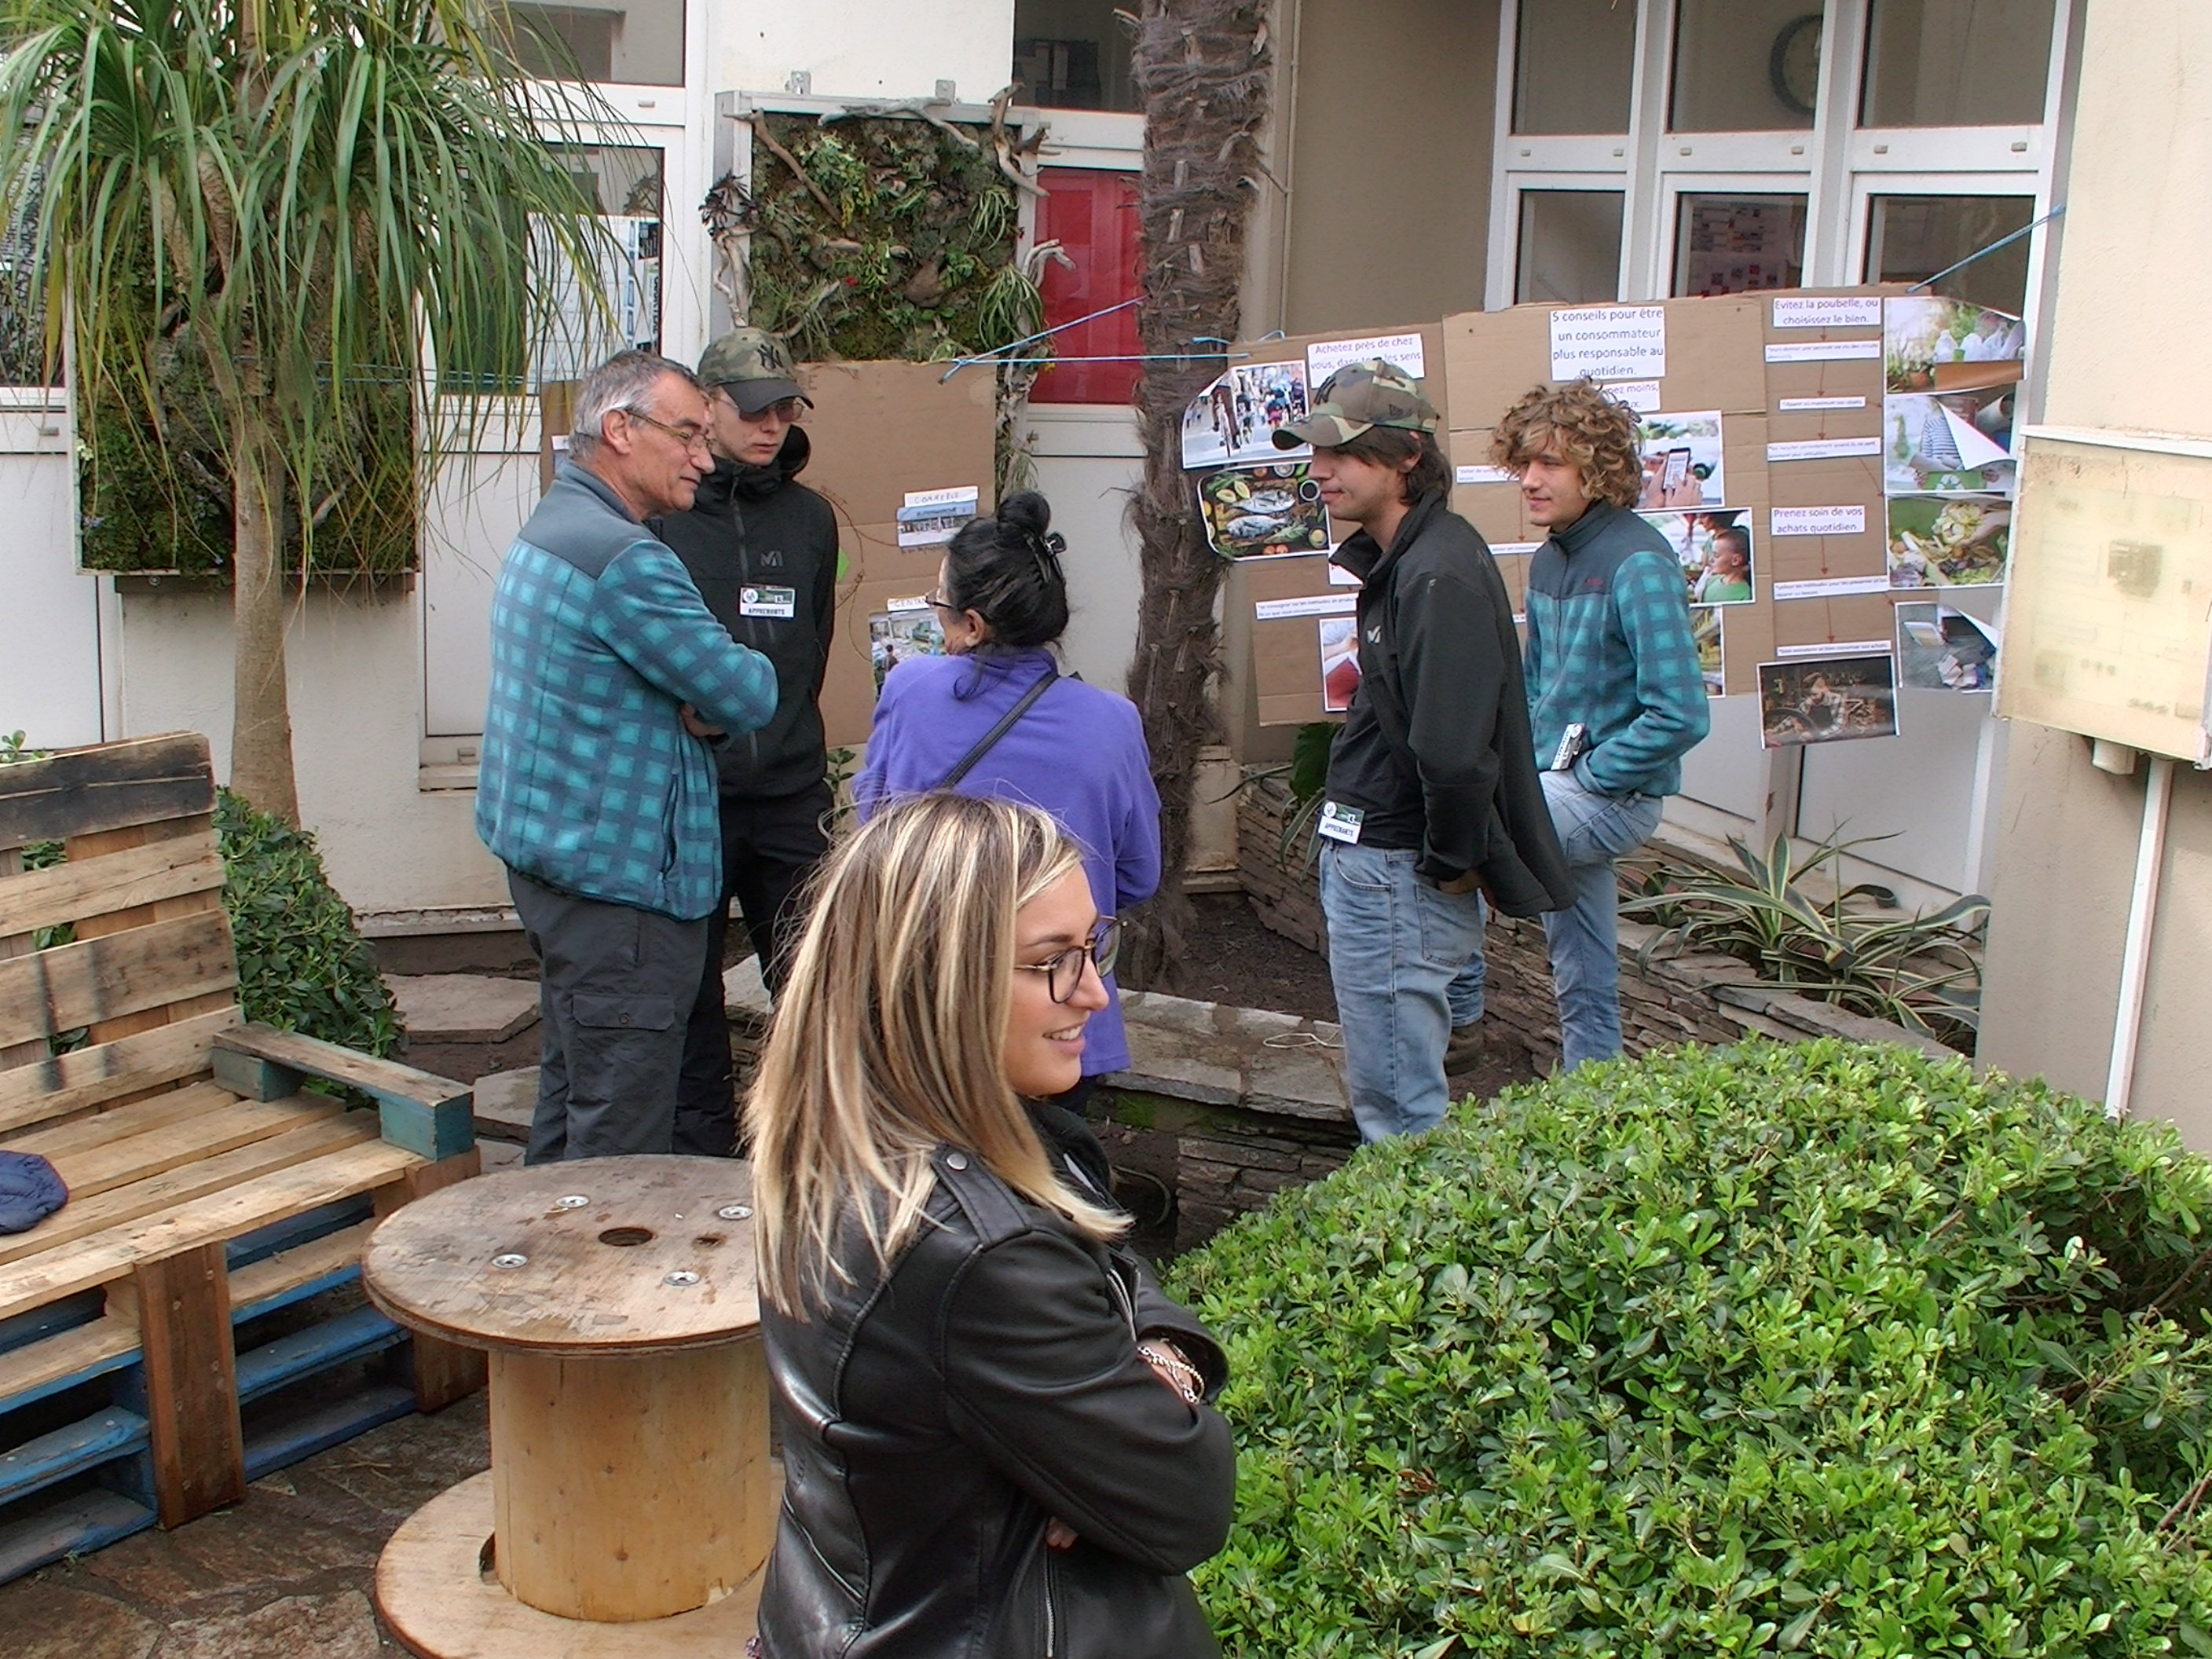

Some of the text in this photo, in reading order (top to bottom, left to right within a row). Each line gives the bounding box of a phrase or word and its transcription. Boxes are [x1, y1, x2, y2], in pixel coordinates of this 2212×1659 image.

[1806, 299, 1815, 309] la
[1817, 298, 1863, 309] poubelle,
[1562, 309, 1607, 322] conseils
[1610, 311, 1636, 322] pour
[1639, 308, 1663, 319] être
[1782, 314, 1870, 325] choisissez le bien.
[1575, 328, 1661, 341] consommateur
[1314, 336, 1414, 354] Achetez près de chez
[1552, 346, 1664, 361] plus responsable au
[1310, 361, 1335, 370] vous,
[1400, 351, 1422, 360] sens
[1579, 364, 1638, 377] quotidien.
[1774, 507, 1863, 518] Prenez soin de vos
[1776, 522, 1860, 534] achats quotidien.
